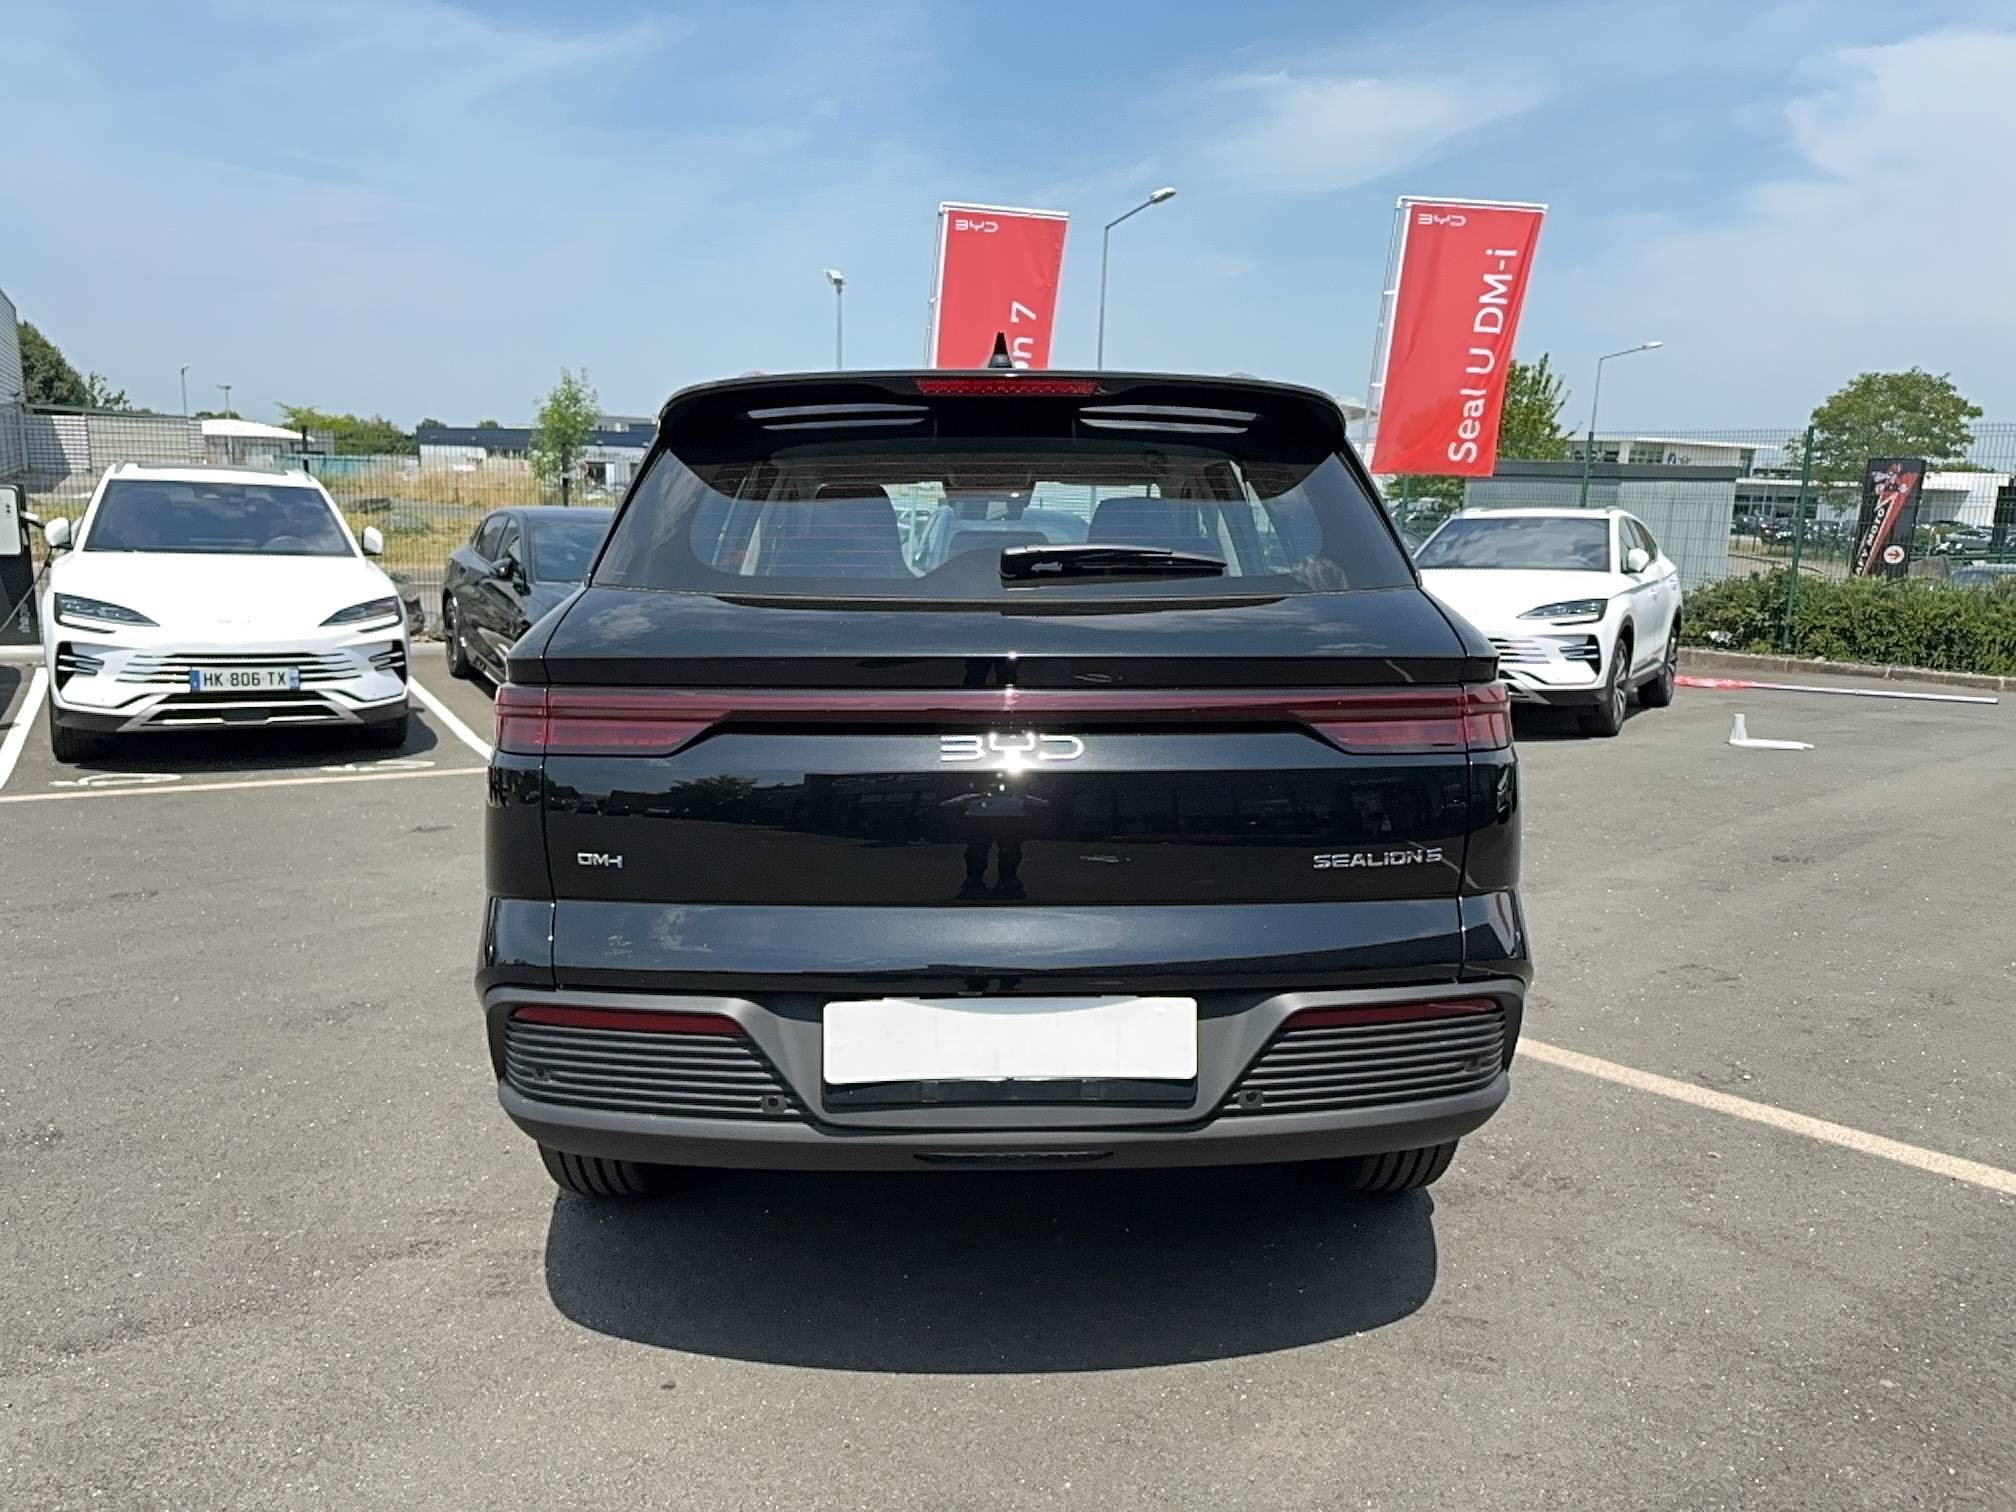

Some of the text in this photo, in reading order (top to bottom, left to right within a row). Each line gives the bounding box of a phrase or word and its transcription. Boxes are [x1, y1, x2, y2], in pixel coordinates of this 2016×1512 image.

[955, 218, 999, 233] BYD
[1418, 213, 1467, 227] BYD
[1010, 301, 1037, 323] 7
[1449, 248, 1518, 464] Seal U DM-i
[203, 671, 286, 687] HK 806 TX
[939, 733, 1084, 767] BYD
